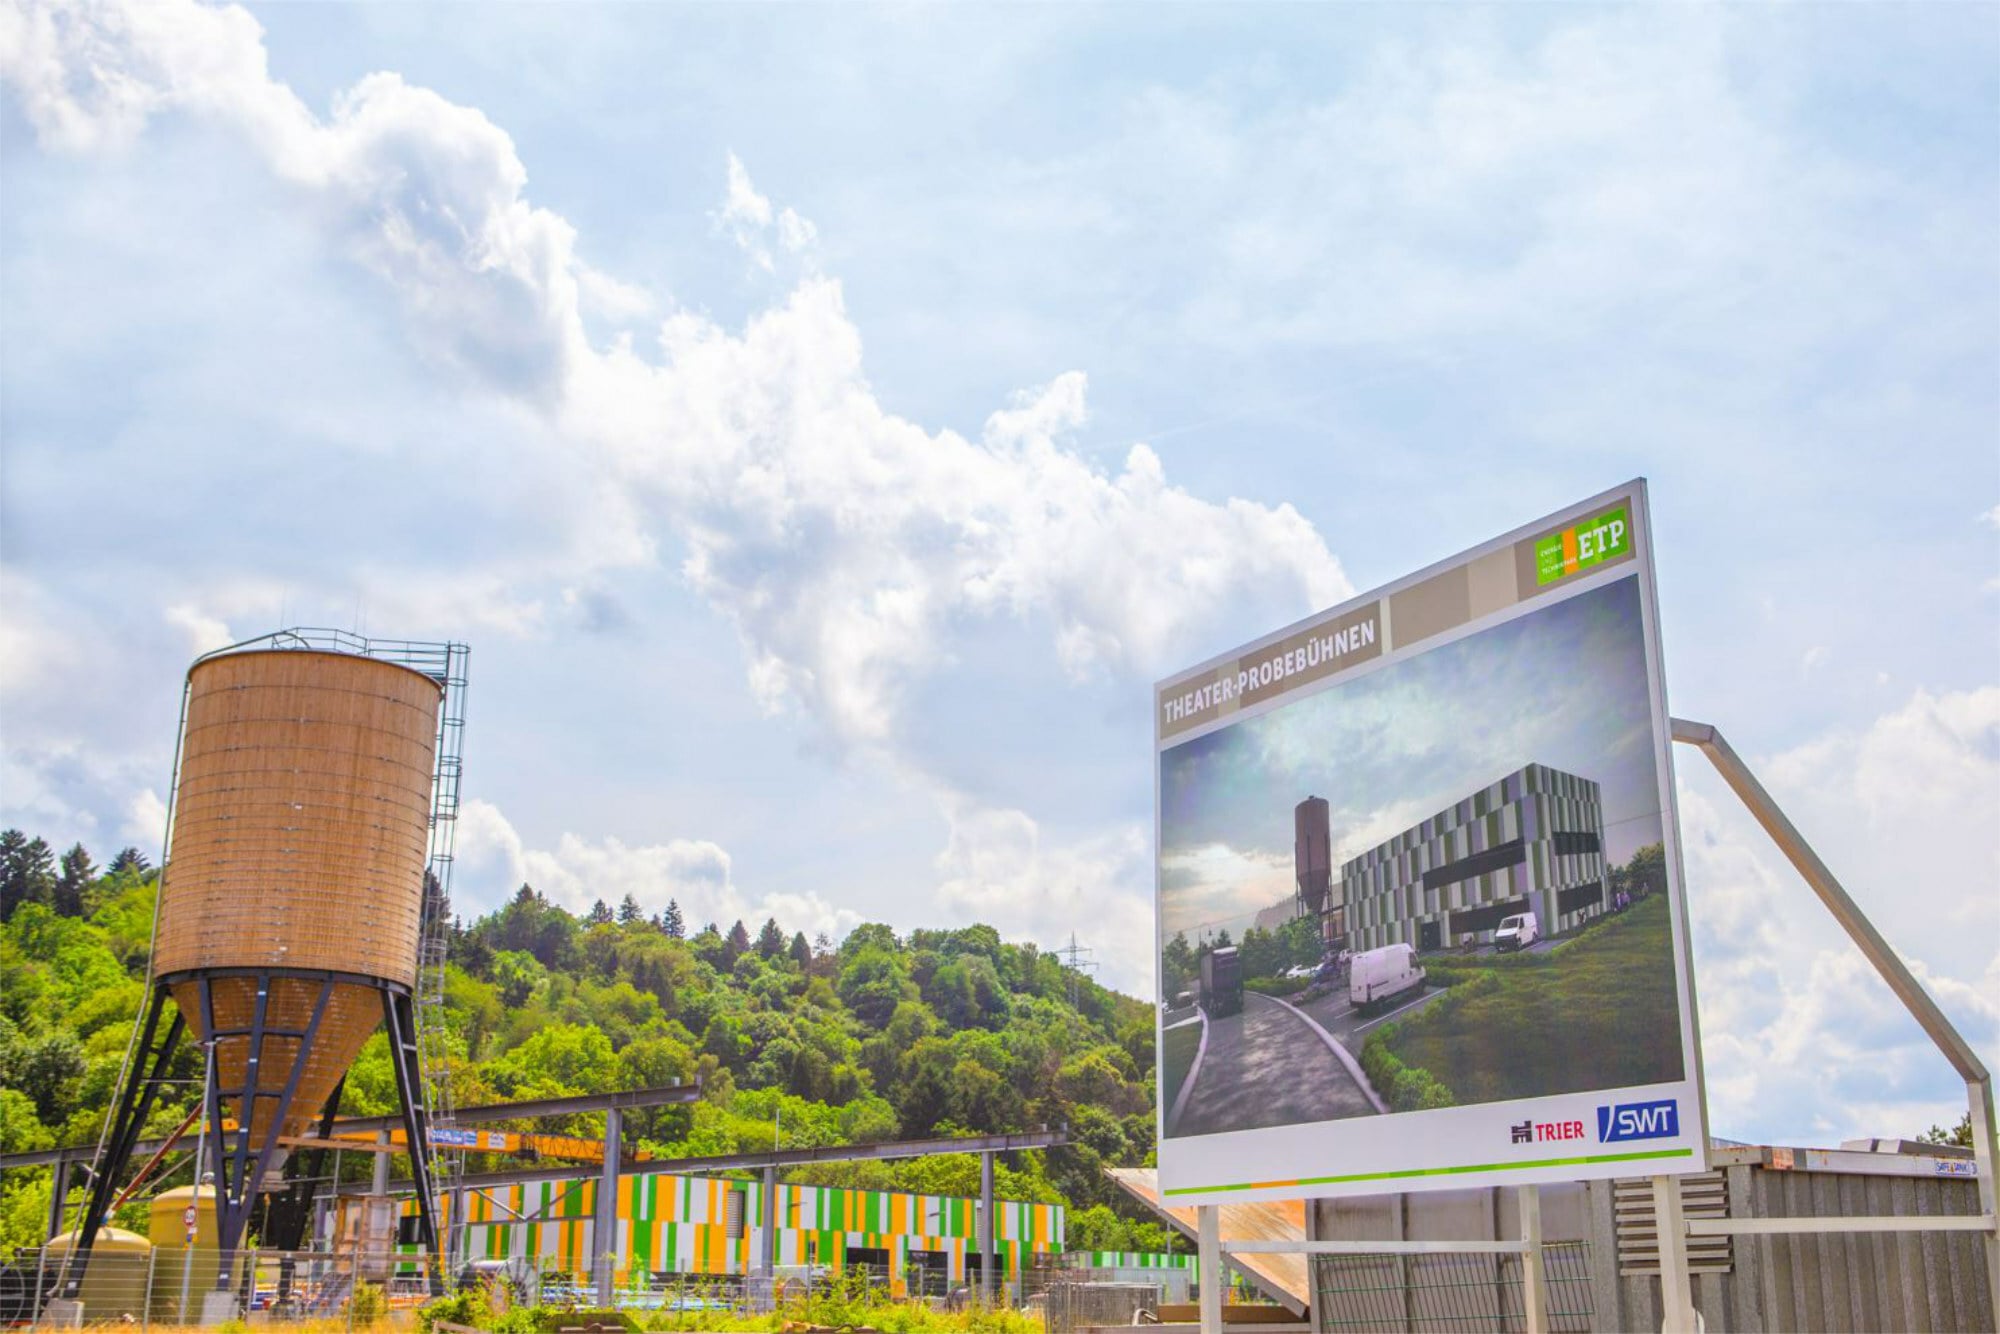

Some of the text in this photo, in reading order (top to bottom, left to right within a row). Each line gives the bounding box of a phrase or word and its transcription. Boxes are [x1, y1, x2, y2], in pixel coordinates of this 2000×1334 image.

[1578, 519, 1625, 561] ETP
[1164, 619, 1375, 723] THEATER-PROBEBÜHNEN
[1536, 1120, 1585, 1142] TRIER
[1618, 1106, 1672, 1136] SWT
